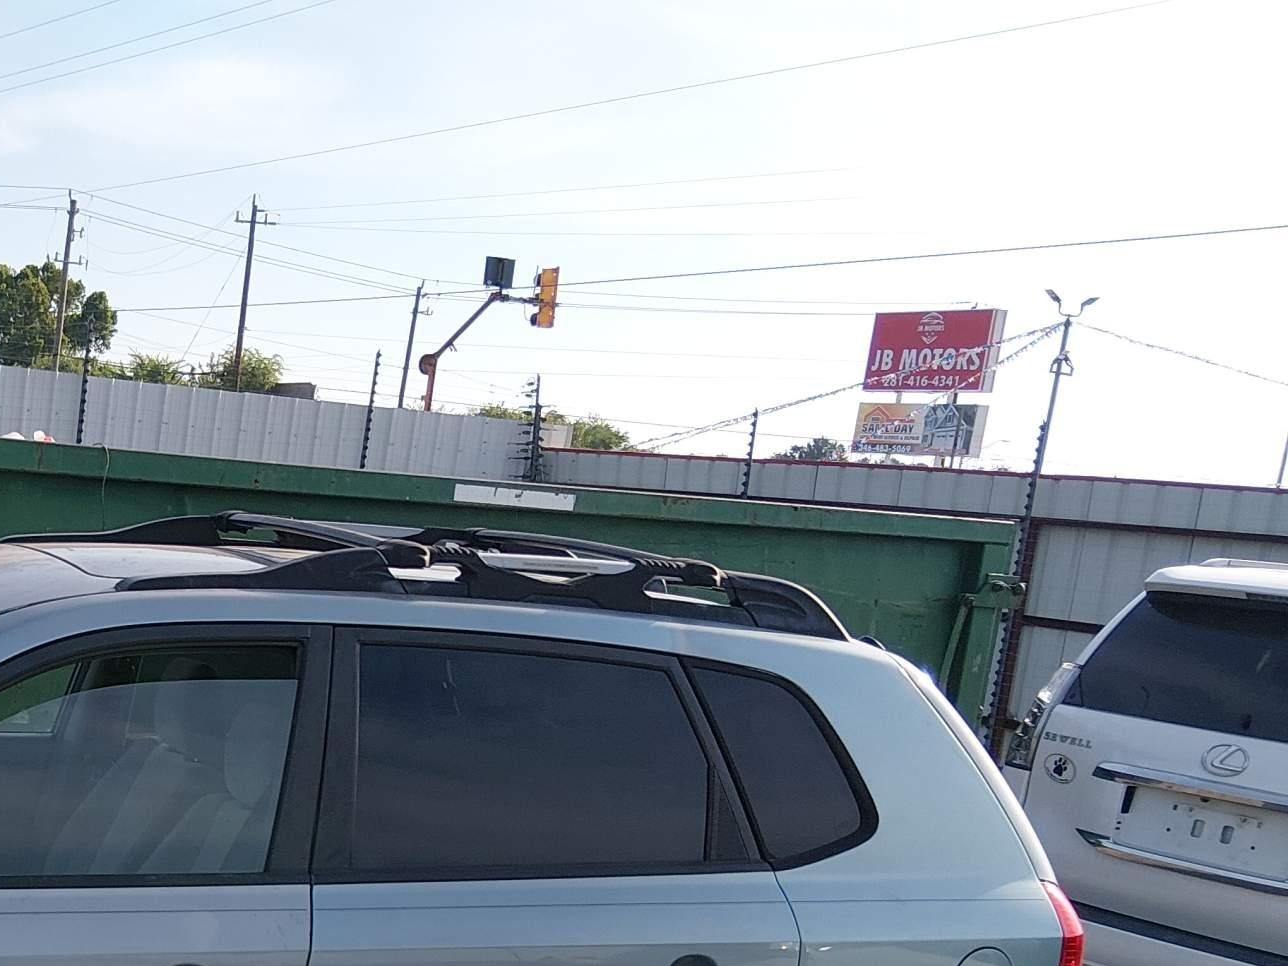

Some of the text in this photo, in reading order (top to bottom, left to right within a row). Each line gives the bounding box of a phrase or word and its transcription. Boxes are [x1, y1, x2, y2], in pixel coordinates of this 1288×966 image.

[871, 347, 981, 372] JB MOTORS
[883, 375, 960, 387] 281-416-4341
[862, 423, 914, 433] SAME DAY
[1043, 731, 1092, 748] SEWELL
